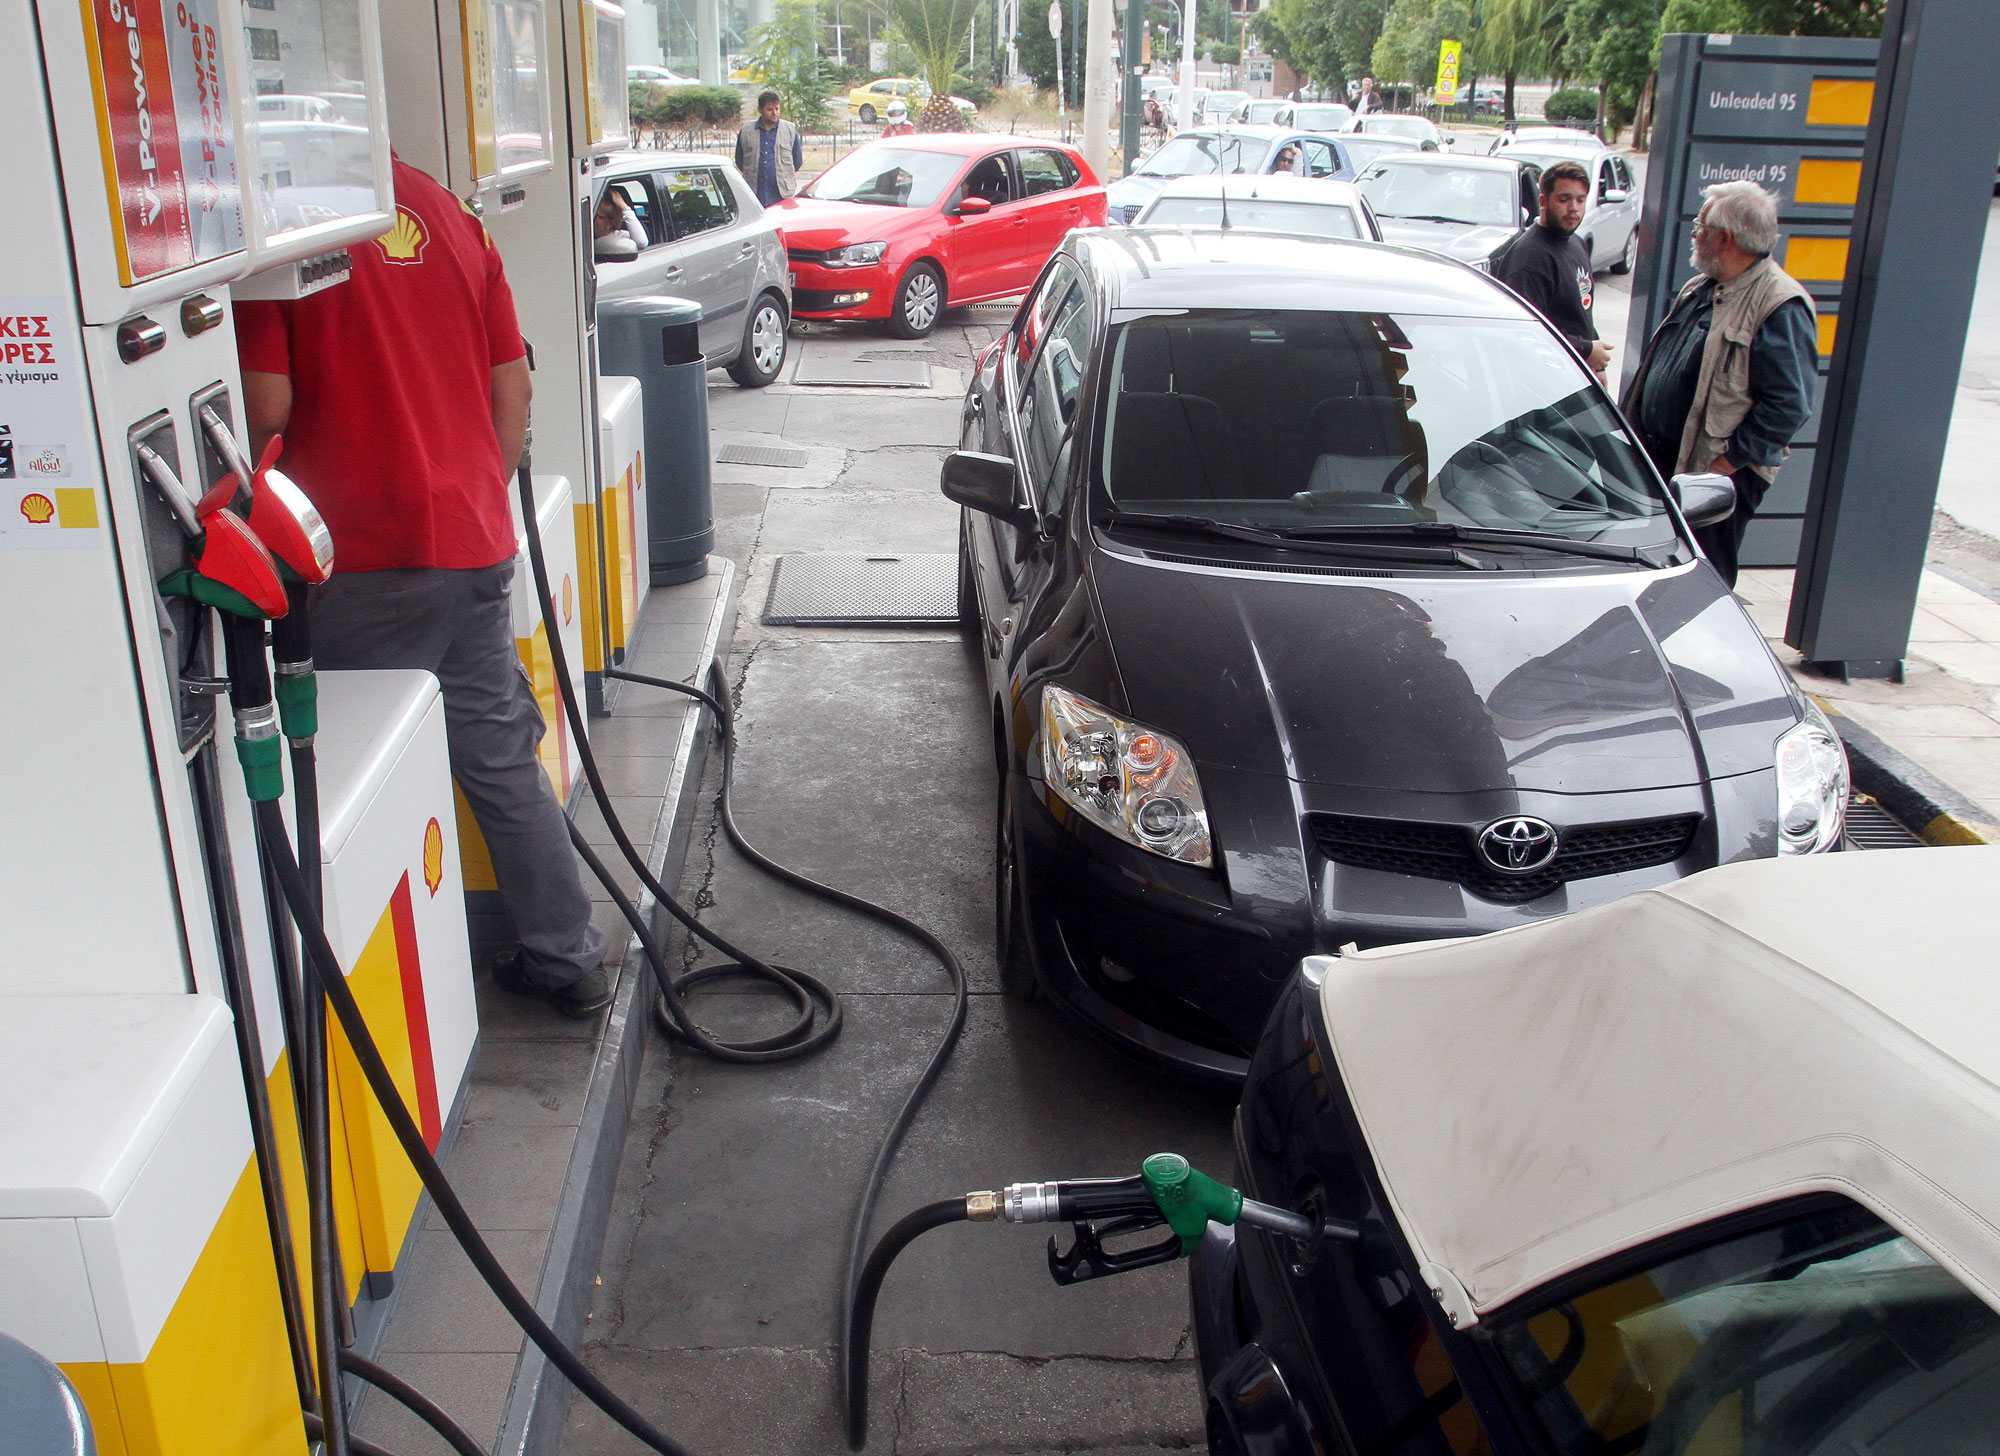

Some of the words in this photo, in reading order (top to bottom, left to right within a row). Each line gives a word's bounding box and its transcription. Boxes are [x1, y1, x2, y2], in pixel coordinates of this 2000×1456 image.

[203, 24, 226, 148] Racing
[1709, 91, 1777, 110] Unleaded
[1779, 93, 1797, 111] 95
[123, 5, 162, 226] V-Power
[188, 13, 218, 213] V-Power
[1700, 163, 1768, 181] Unleaded
[1769, 165, 1788, 182] 95
[137, 187, 148, 227] Shell
[173, 170, 190, 251] Unleaded
[199, 177, 208, 213] Shll
[229, 161, 243, 237] Unleded
[0, 343, 56, 364] ΡΕΣ
[5, 369, 59, 384] γέμισμα
[29, 457, 61, 473] Allou!
